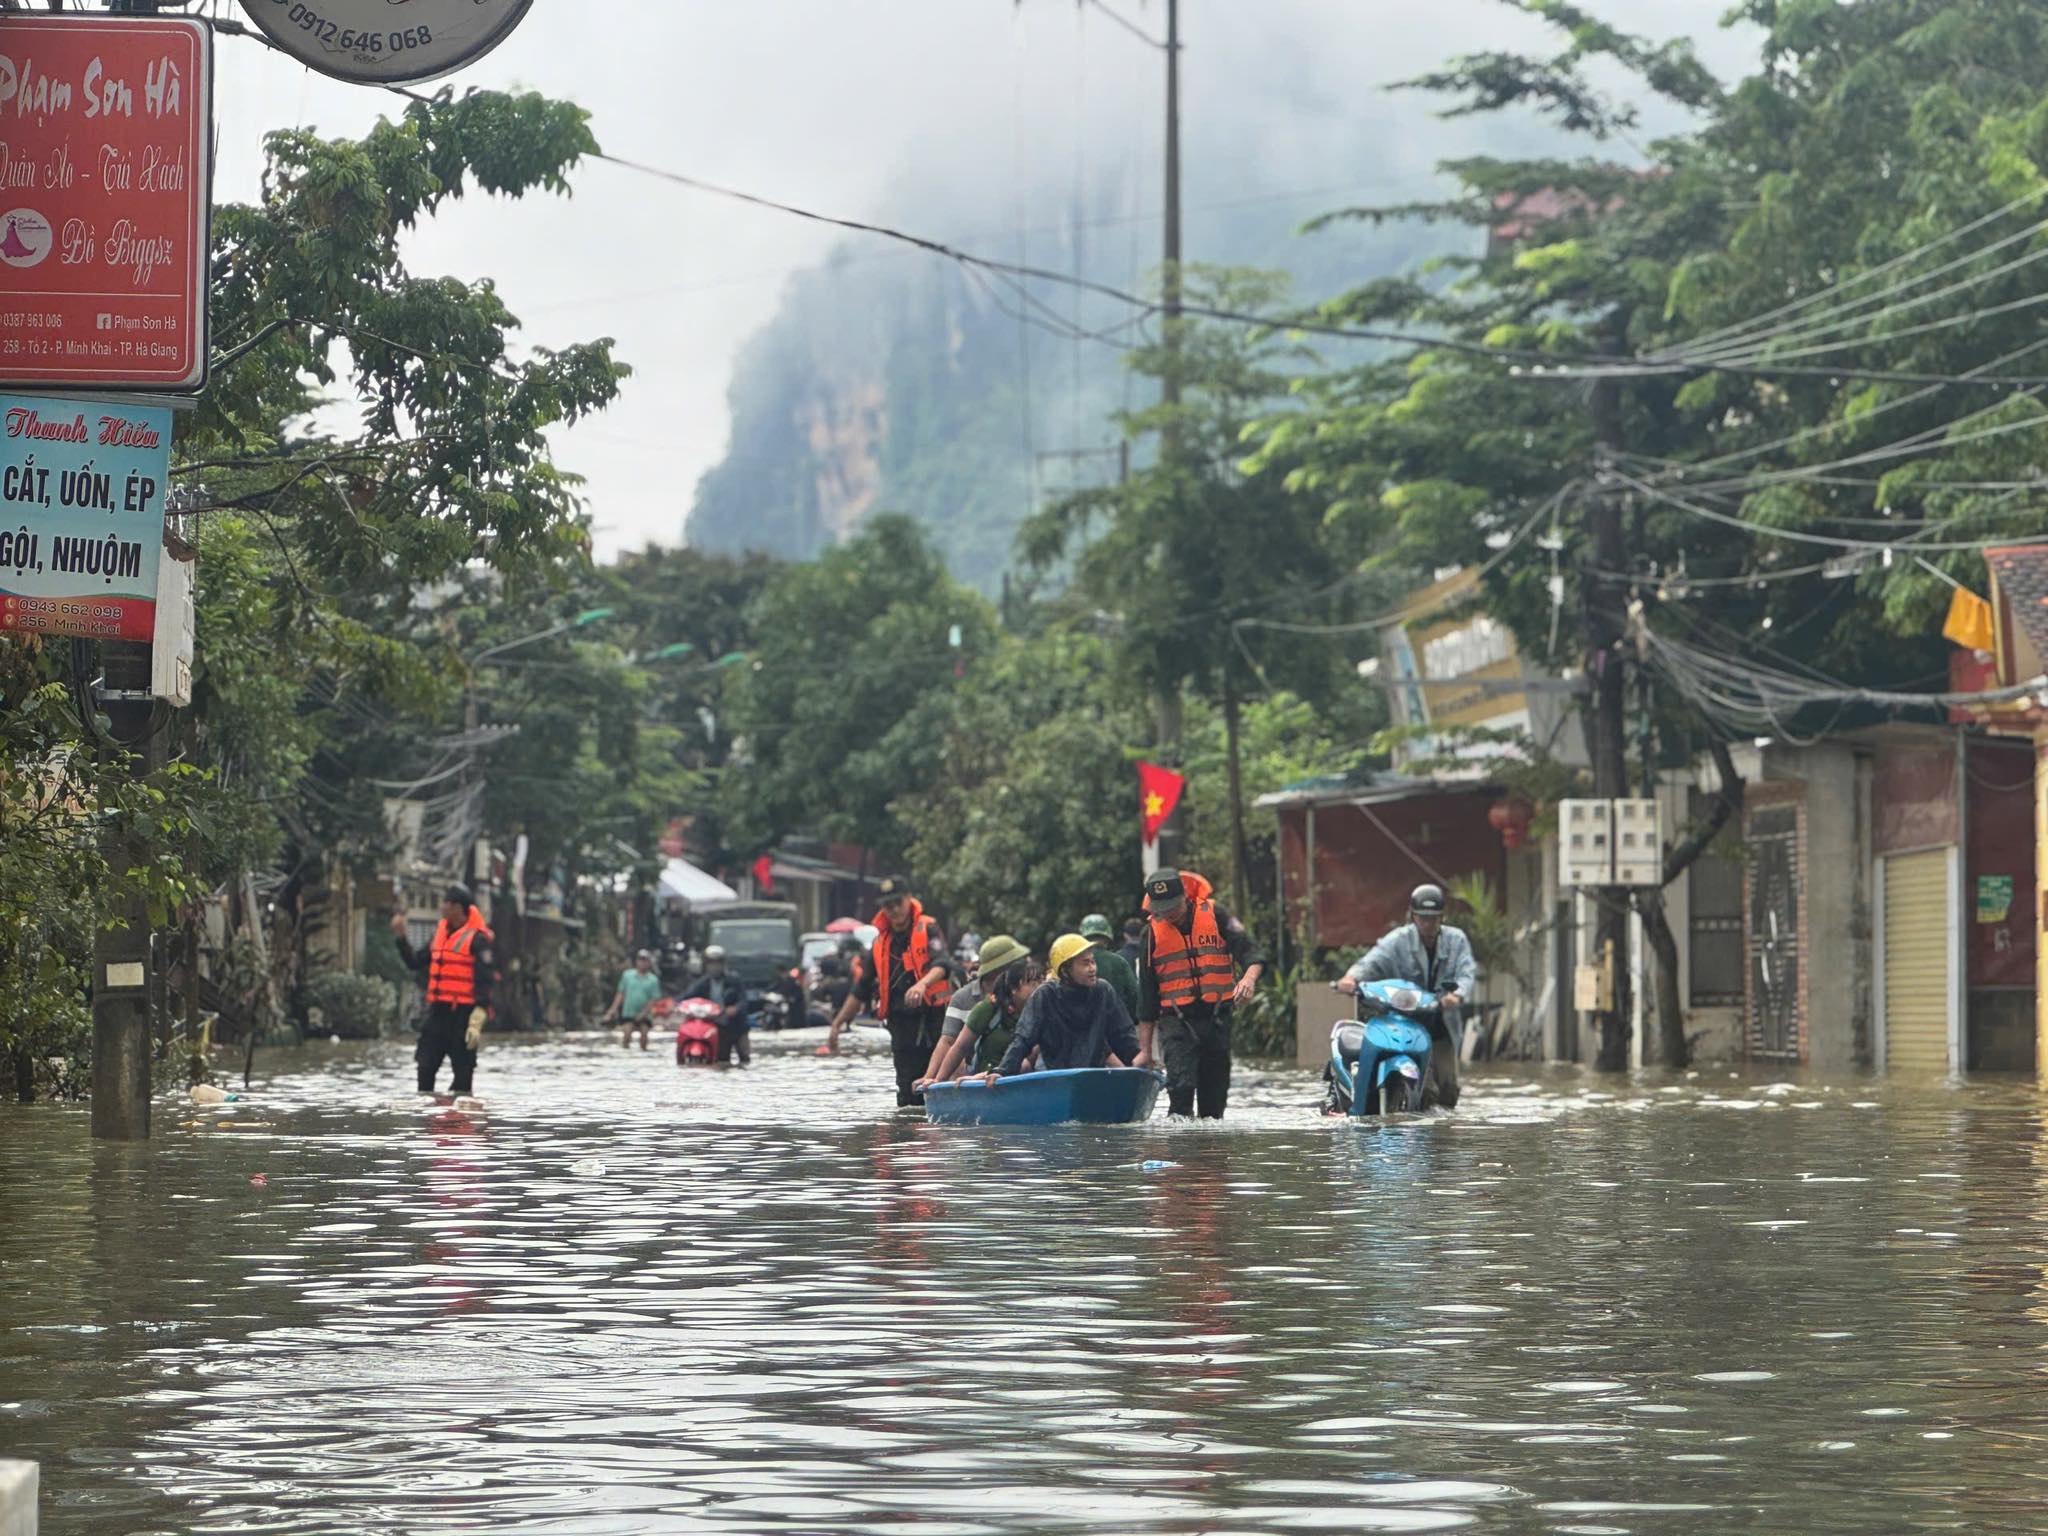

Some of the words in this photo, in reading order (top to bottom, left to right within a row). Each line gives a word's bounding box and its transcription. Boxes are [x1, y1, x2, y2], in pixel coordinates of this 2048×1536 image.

[287, 4, 338, 43] 0912
[340, 29, 382, 52] 646
[389, 25, 432, 52] 068
[0, 54, 72, 128] Phạm
[145, 56, 181, 120] Hà
[60, 218, 95, 265] Đồ
[41, 340, 48, 354] 2
[66, 340, 88, 355] Minh
[91, 341, 112, 355] Khai
[150, 342, 178, 361] Giang
[5, 407, 89, 443] Thanh
[3, 453, 50, 509] CẮT,
[60, 459, 116, 514] UỐN,
[124, 468, 155, 512] ÉP
[0, 525, 43, 575] GỘI,
[52, 533, 142, 584] NHUỘM
[19, 599, 57, 614] 0943
[61, 603, 90, 616] 662
[19, 615, 48, 628] 256
[54, 619, 86, 632] Minh
